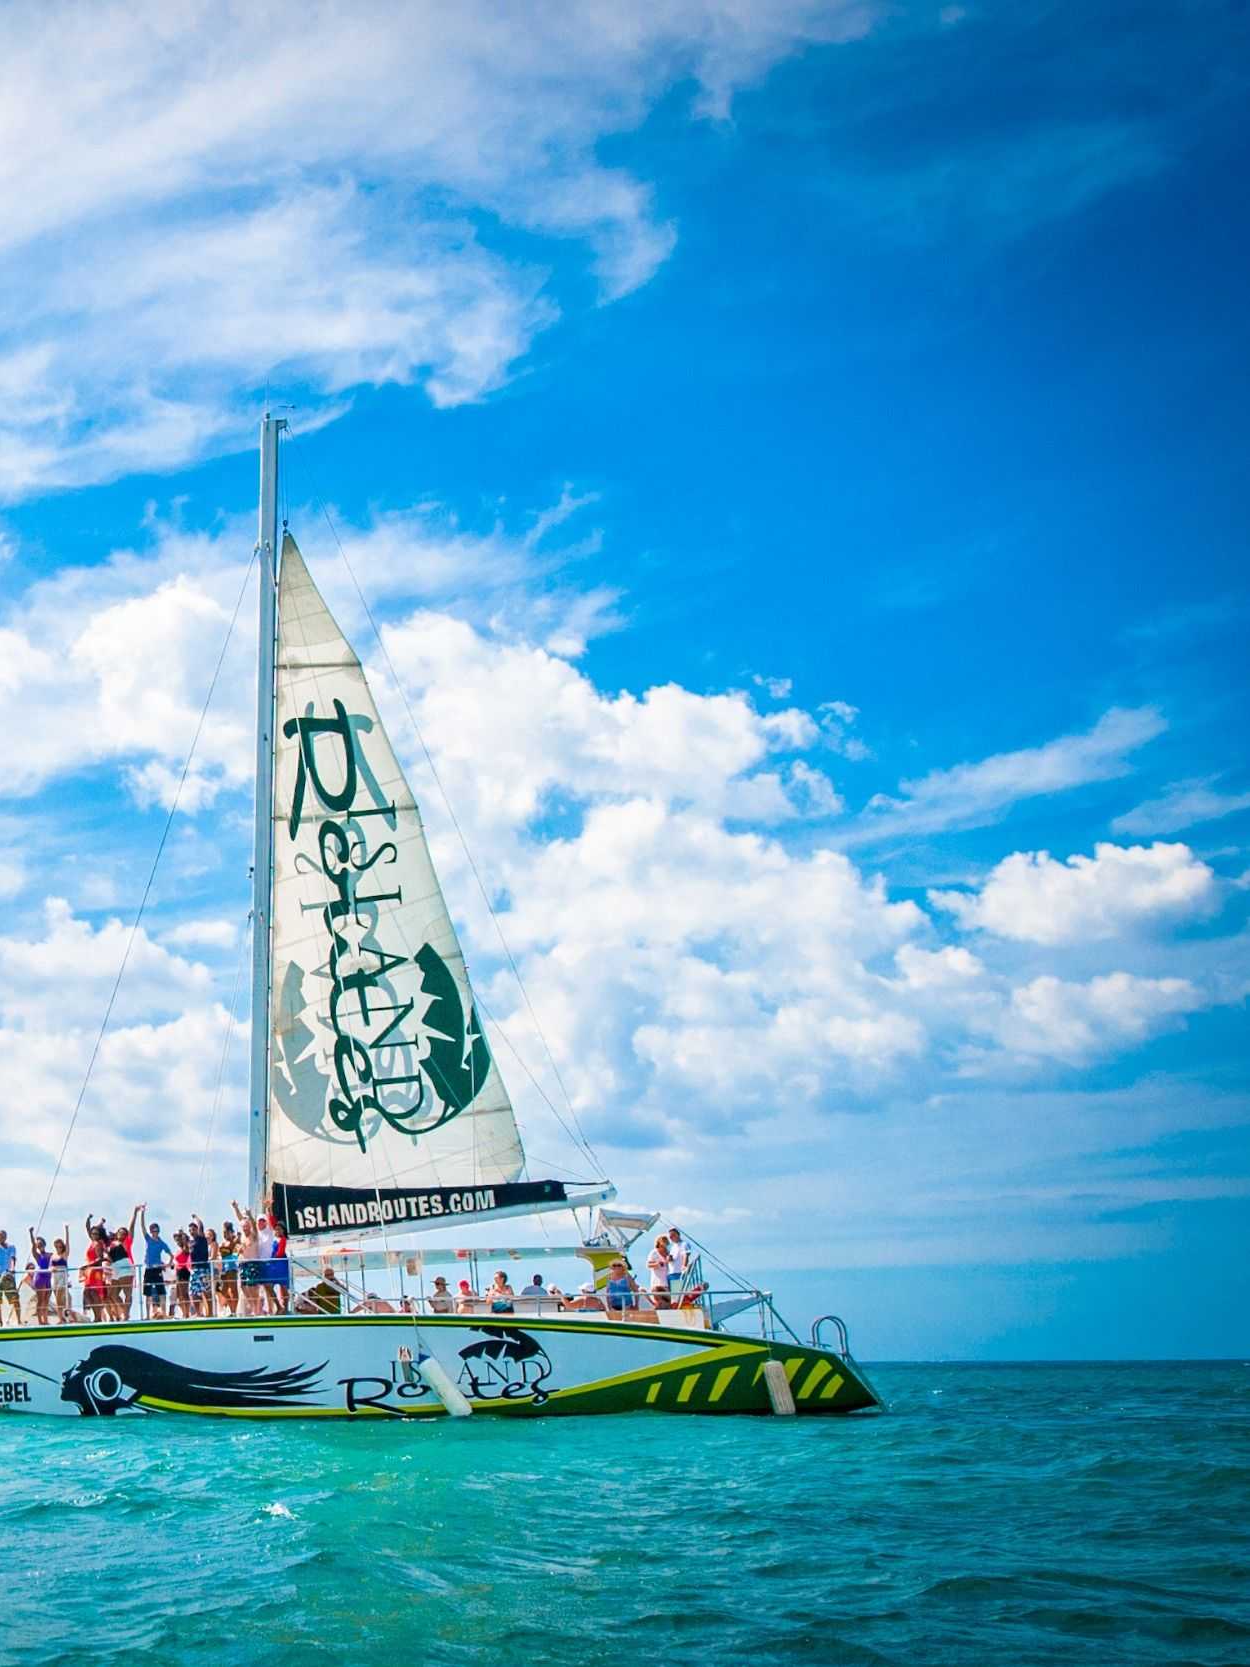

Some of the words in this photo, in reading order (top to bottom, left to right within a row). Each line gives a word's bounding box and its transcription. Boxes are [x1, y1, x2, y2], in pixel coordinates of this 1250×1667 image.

[348, 800, 425, 1119] ISLAND
[389, 1360, 543, 1384] ISAND
[337, 1376, 560, 1415] Rotes
